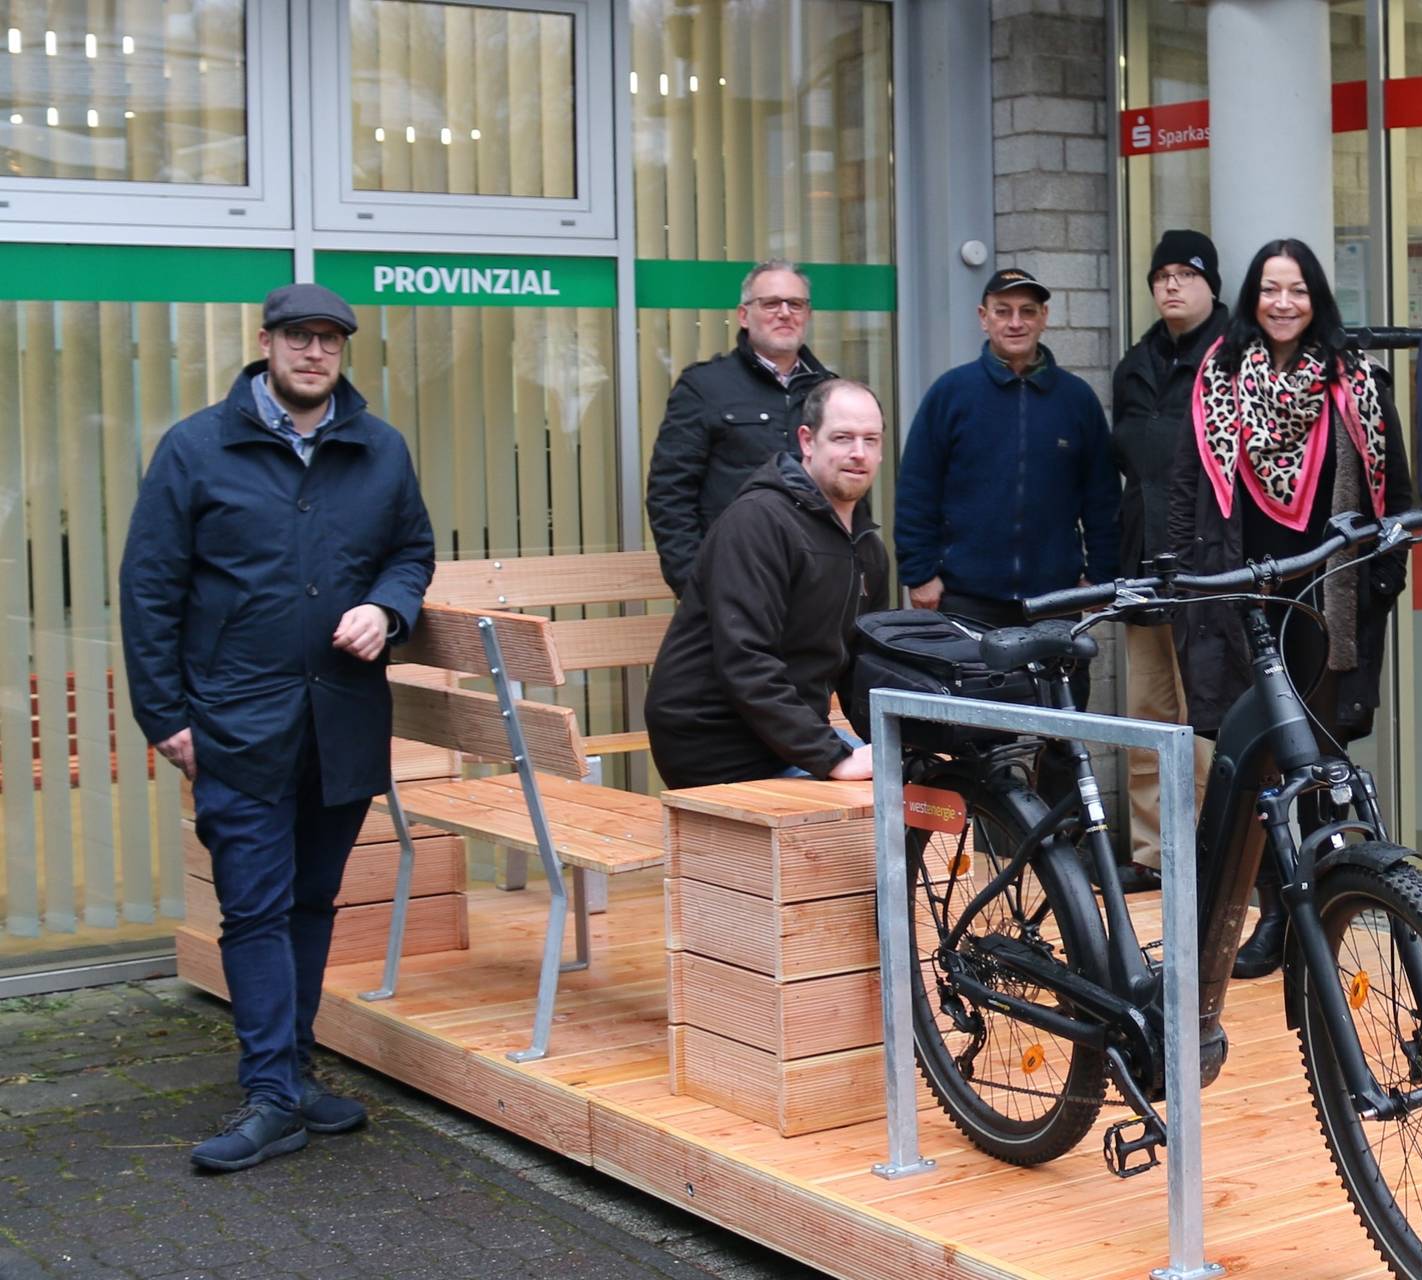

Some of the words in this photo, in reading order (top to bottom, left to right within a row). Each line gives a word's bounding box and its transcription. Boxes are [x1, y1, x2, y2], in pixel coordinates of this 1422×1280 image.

[1157, 125, 1210, 149] Sparkas
[373, 265, 560, 295] PROVINZIAL
[908, 800, 957, 822] westenergie
